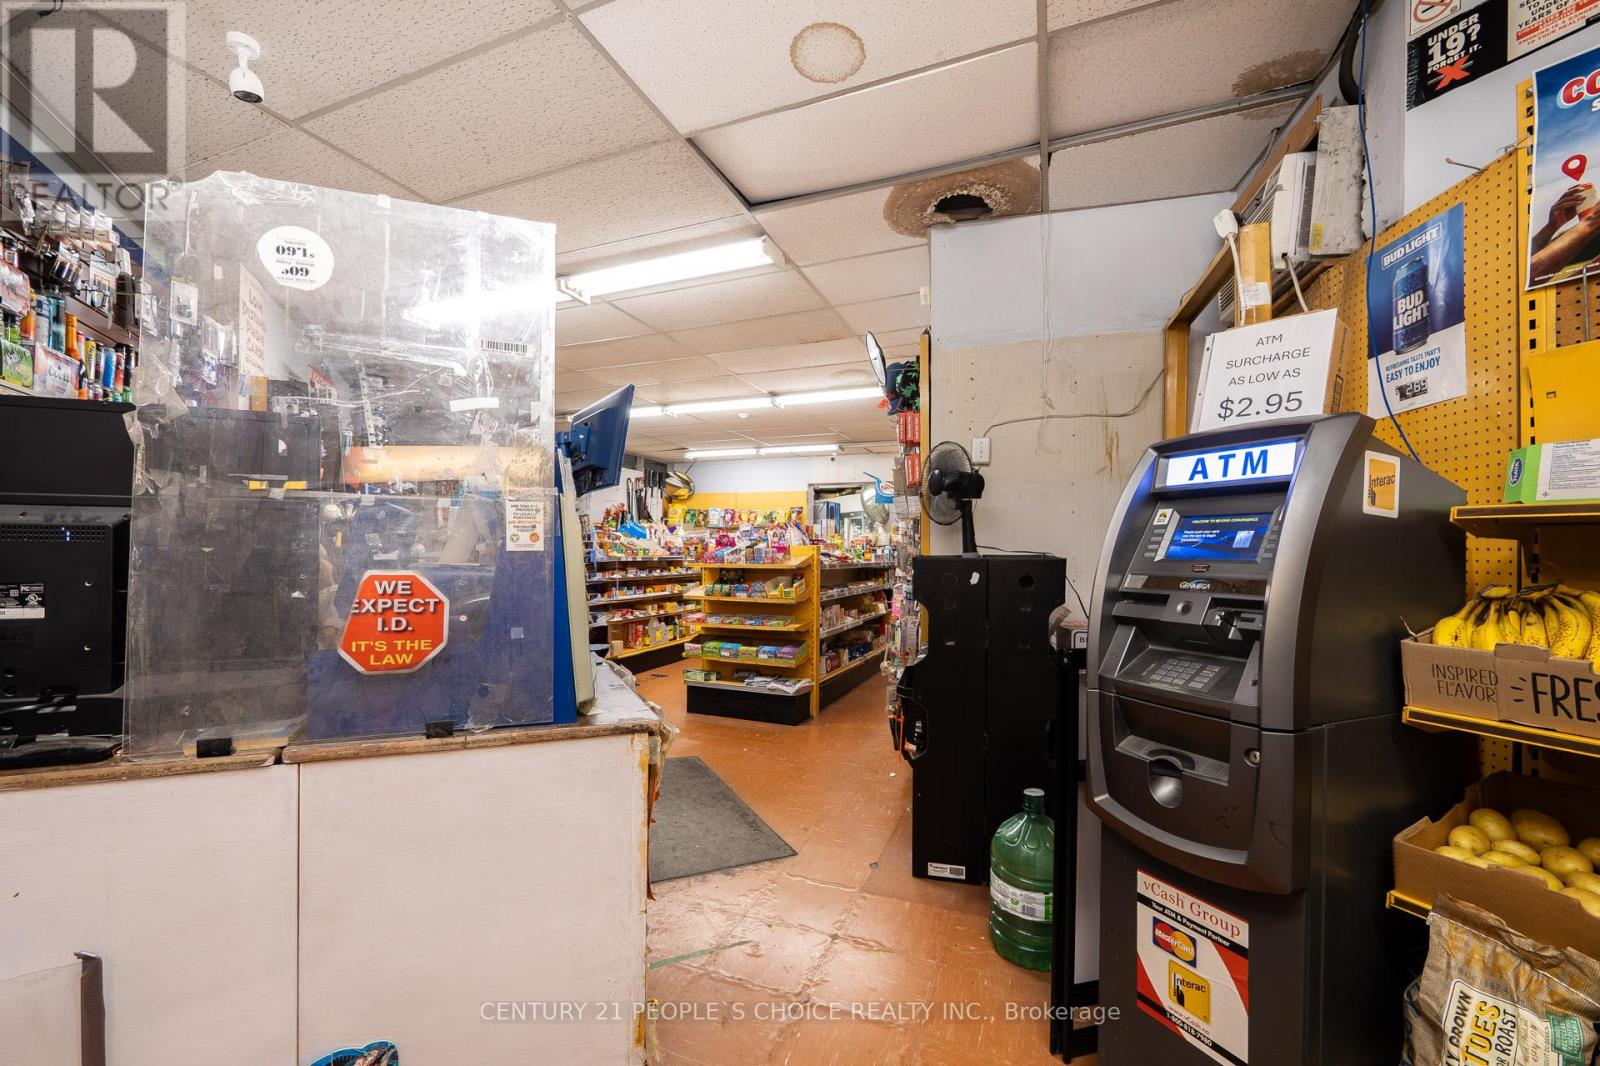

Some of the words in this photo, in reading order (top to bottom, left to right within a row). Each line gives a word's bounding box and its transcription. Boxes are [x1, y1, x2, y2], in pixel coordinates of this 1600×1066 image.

[1427, 13, 1480, 47] UNDER
[1518, 9, 1552, 28] YEARS
[1518, 28, 1550, 45] SMOKING
[1568, 4, 1599, 21] DANGER
[1427, 23, 1481, 67] 19?
[1427, 53, 1465, 73] FORGET
[1468, 44, 1483, 55] IT.
[1383, 247, 1405, 267] BUD
[1405, 226, 1439, 254] LIGHT
[1397, 290, 1424, 314] BUD
[1393, 301, 1430, 331] LIGHT
[1256, 333, 1283, 347] ATM
[1225, 347, 1311, 369] SURCHARGE
[1385, 358, 1410, 372] REFRESHING
[1410, 352, 1424, 362] TASTE
[1424, 346, 1441, 358] THAT'S
[1386, 368, 1405, 383] EASY
[1405, 365, 1414, 377] TO
[1415, 355, 1441, 373] ENJOY
[1228, 376, 1245, 387] AS
[1248, 370, 1280, 384] LOW
[1282, 367, 1301, 379] AS
[1217, 391, 1303, 421] $2.95
[1188, 449, 1268, 481] ATM
[1369, 474, 1395, 488] Interac
[374, 580, 412, 595] WE
[351, 598, 440, 613] EXPECT
[377, 617, 413, 631] I.D.
[351, 640, 388, 652] IT'S
[394, 639, 432, 651] THE
[369, 653, 414, 666] LAW
[1432, 663, 1499, 686] INSPIRED
[1143, 881, 1184, 909] vCash
[1190, 901, 1240, 938] Group
[1151, 901, 1163, 912] Your
[1164, 907, 1176, 918] ATM
[1177, 914, 1182, 922] &
[1182, 917, 1207, 935] Payment
[1208, 930, 1231, 947] Partner
[1154, 928, 1193, 954] MasterCard
[1173, 973, 1206, 994] Interac
[1449, 989, 1474, 1049] GROWN
[1494, 1008, 1517, 1057] ROAST
